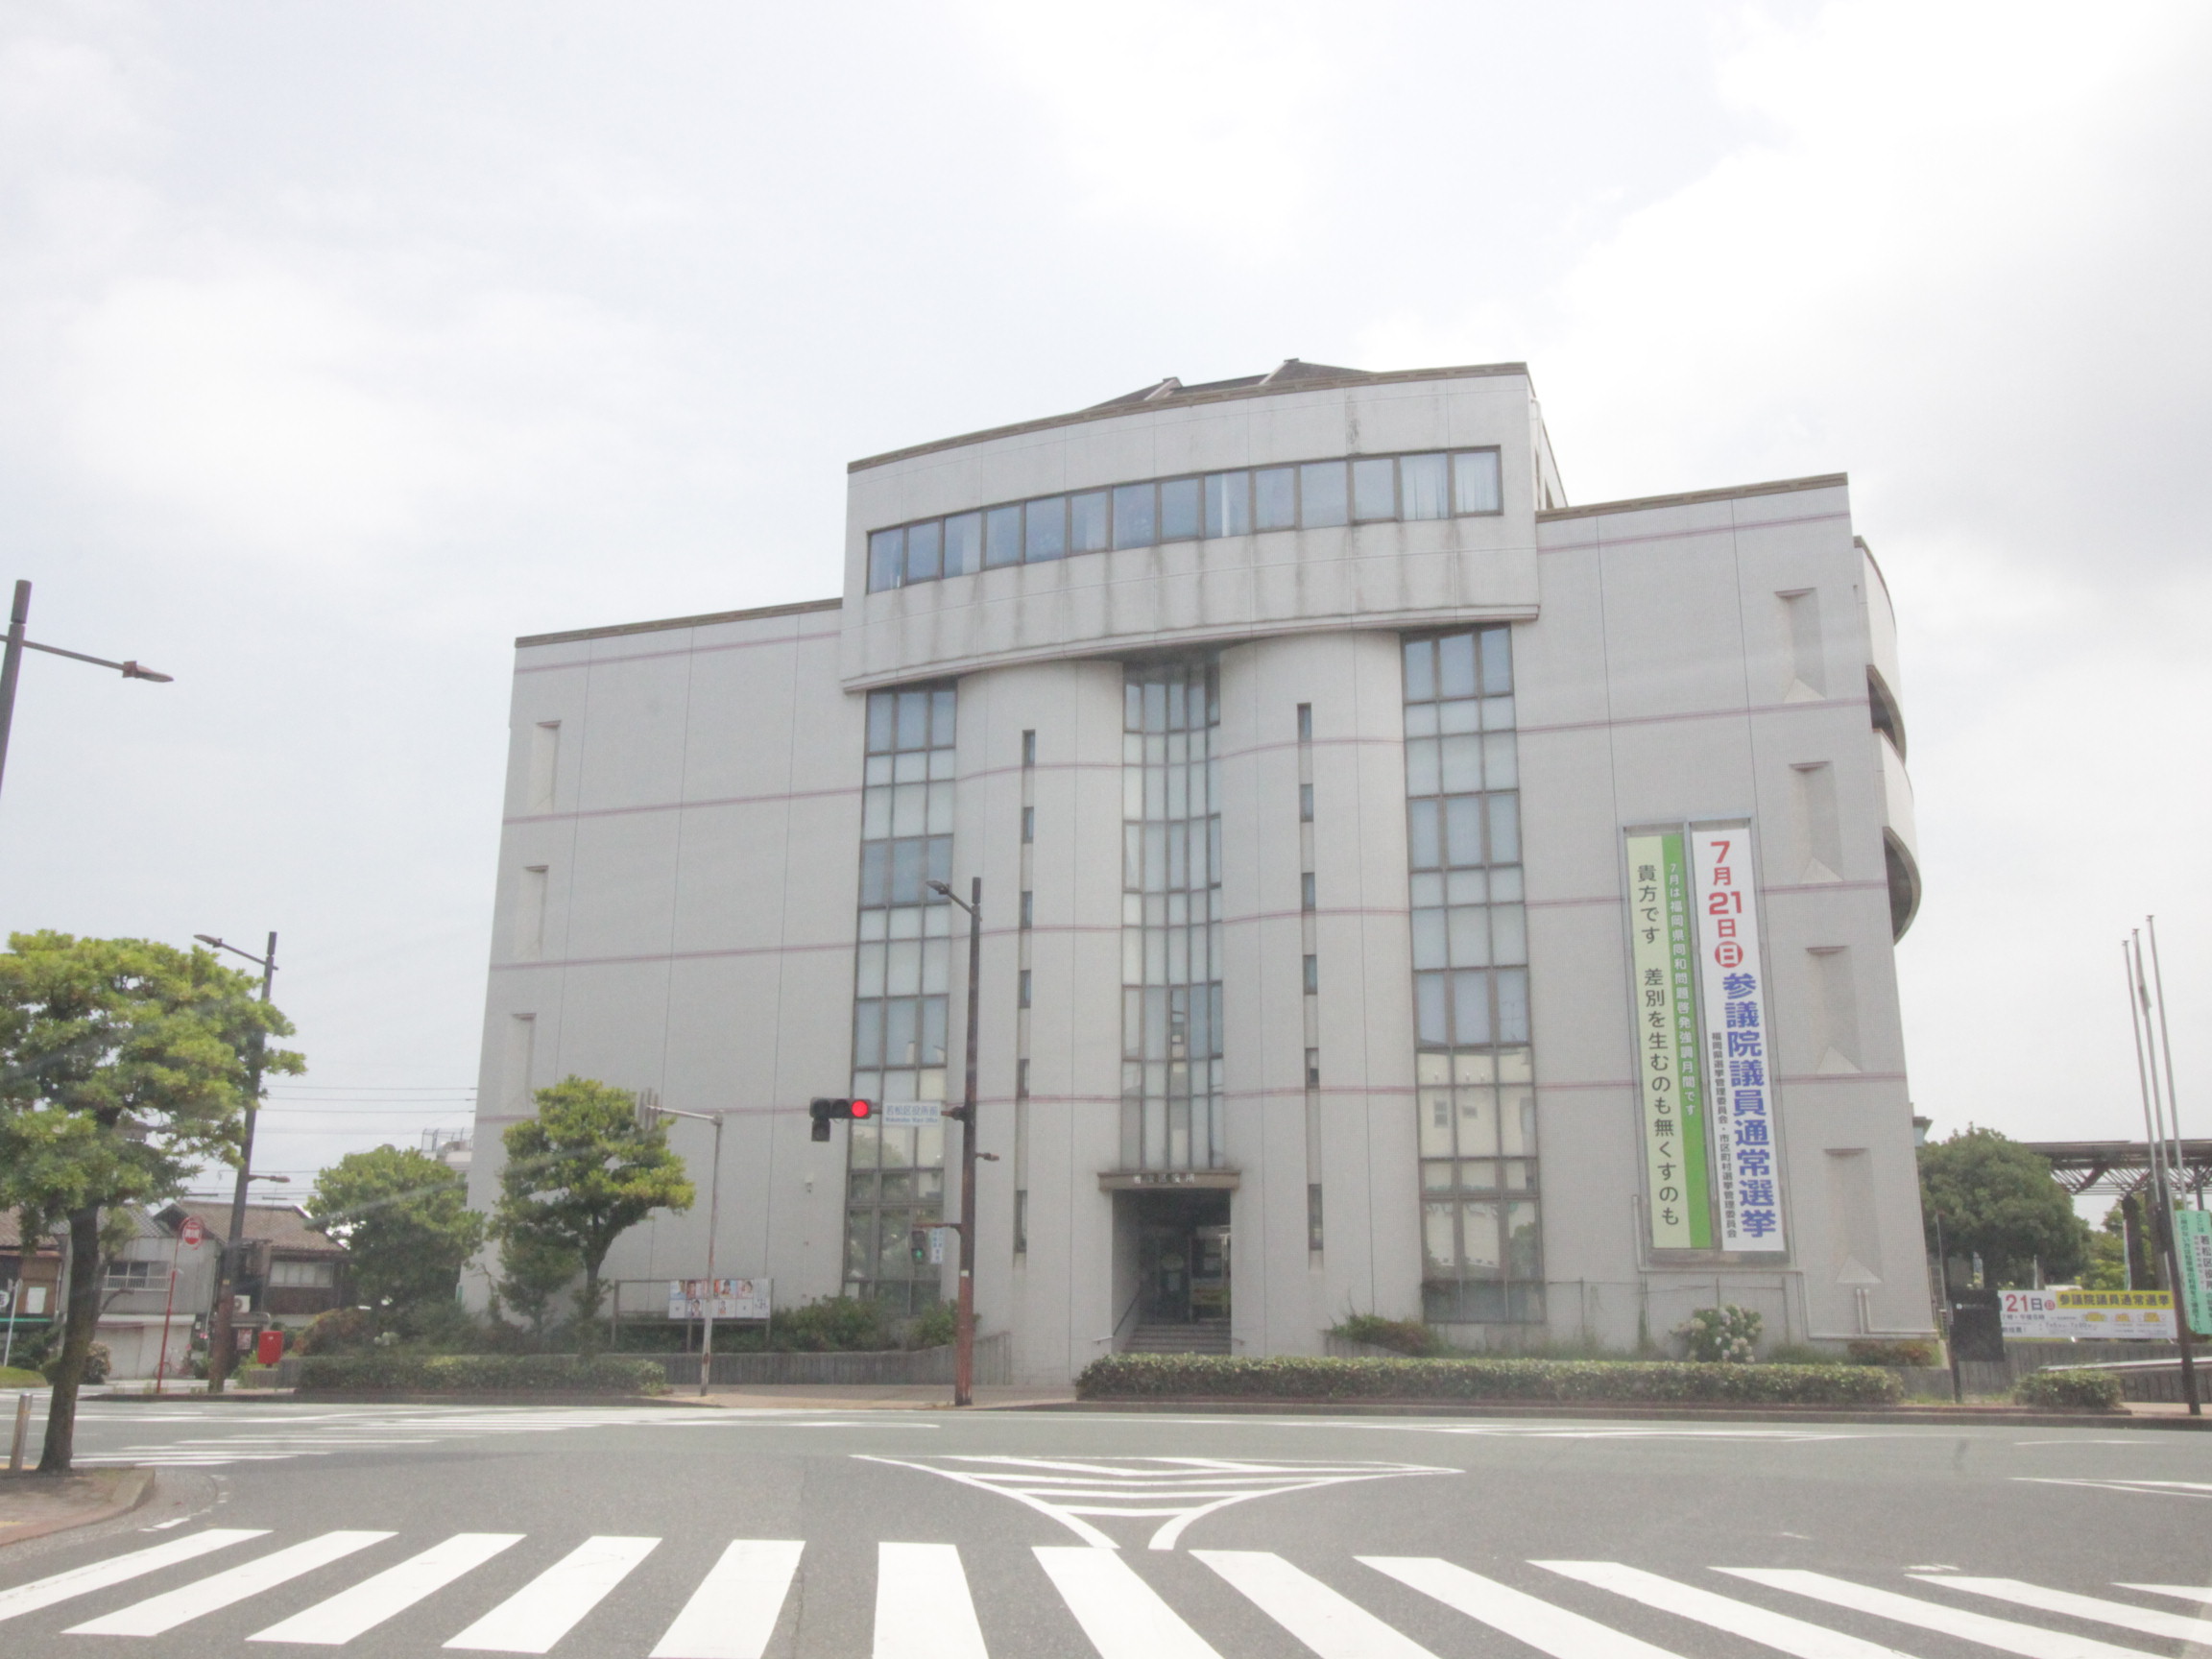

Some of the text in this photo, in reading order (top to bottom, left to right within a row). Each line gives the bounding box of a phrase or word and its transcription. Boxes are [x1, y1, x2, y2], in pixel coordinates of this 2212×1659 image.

[1637, 864, 1679, 1226] 貴方です 差別を生むのも無くすのも
[1670, 864, 1696, 1117] 7月は福岡県同和問題啓発強調月間です
